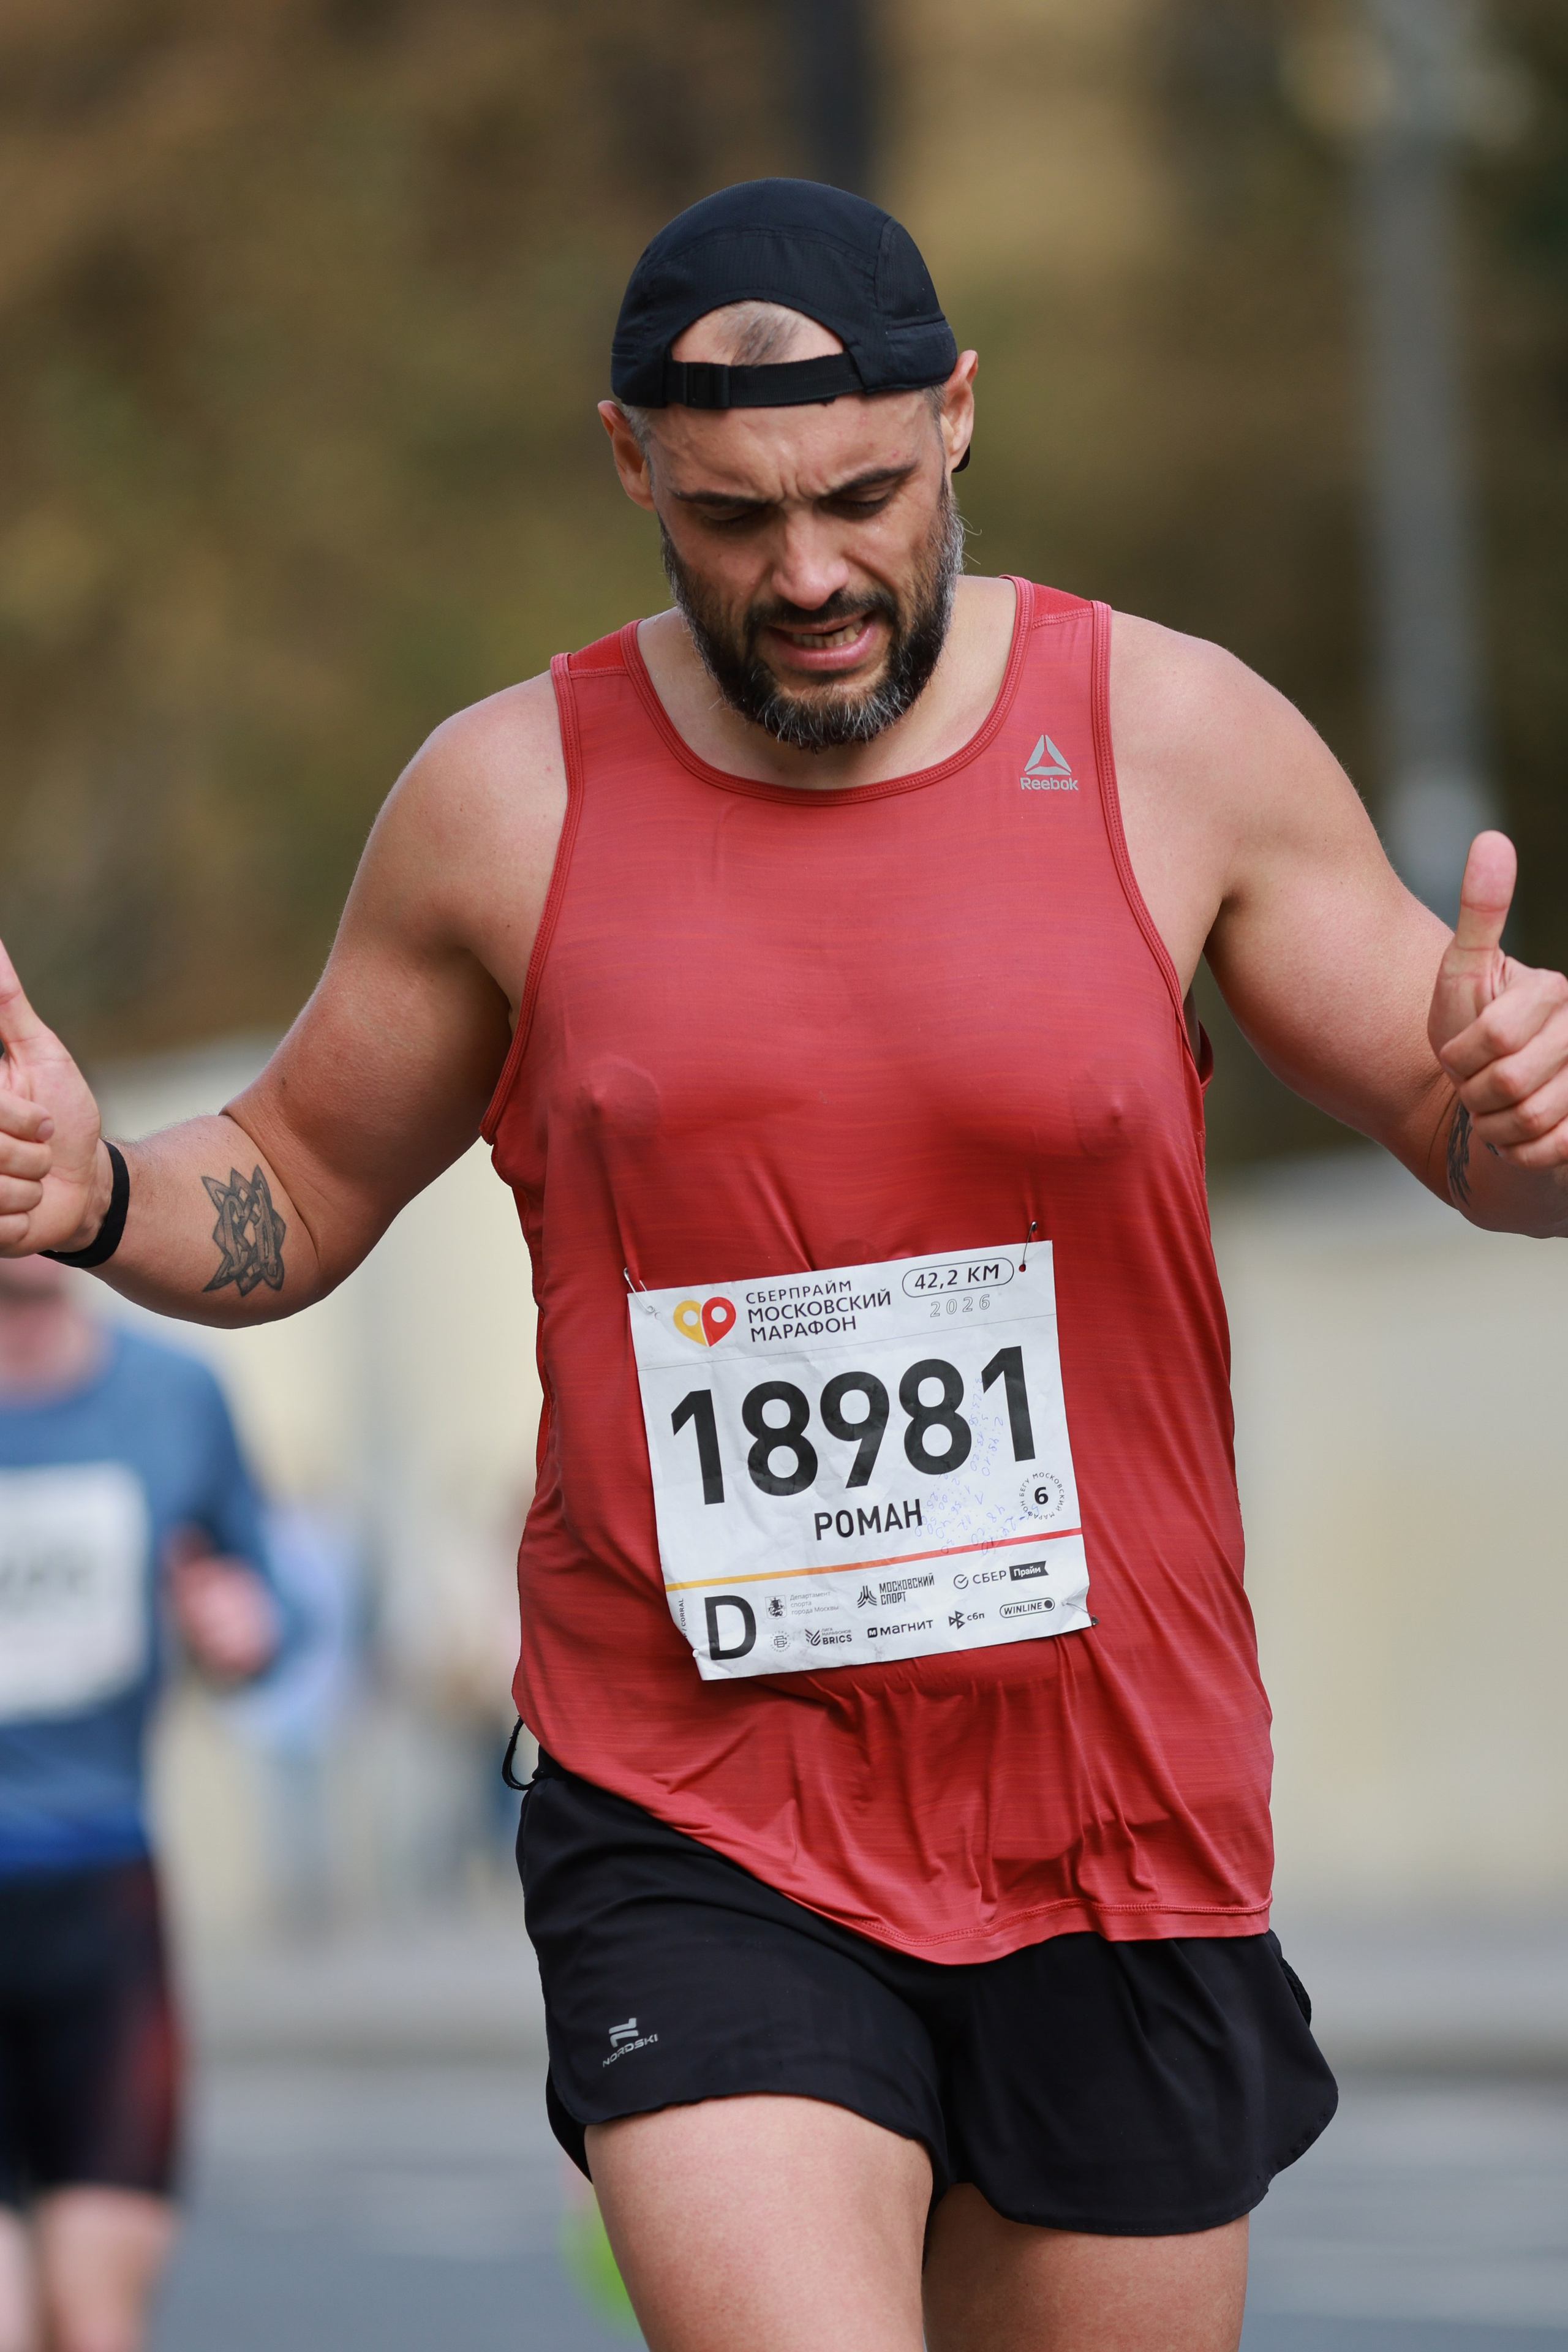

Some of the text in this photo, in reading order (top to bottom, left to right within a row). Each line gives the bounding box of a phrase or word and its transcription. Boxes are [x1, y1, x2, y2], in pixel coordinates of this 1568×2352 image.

[1020, 777, 1079, 791] Reebok
[914, 1264, 999, 1289] 42,2 КМ
[746, 1280, 851, 1304] СБЕРПРАЙМ
[748, 1288, 891, 1324] МОСКОВСКИЙ
[930, 1294, 990, 1317] 2026
[750, 1316, 856, 1342] МАРАФОН
[670, 1346, 1036, 1505] 18981
[1019, 1478, 1030, 1497] БЕГУ
[1032, 1472, 1065, 1512] МОСКОВСКИЙ
[1034, 1487, 1049, 1505] 6
[815, 1499, 922, 1540] РОМАН
[879, 1573, 935, 1594] МОСКОВСКИЙ
[973, 1566, 1041, 1584] СБЕР Прайм
[790, 1591, 831, 1601] Департамент
[881, 1591, 906, 1605] СПОРТ
[967, 1612, 985, 1621] сбп
[1004, 1602, 1042, 1615] WINLINE
[704, 1595, 757, 1660] D
[880, 1620, 933, 1636] магнит
[823, 1634, 853, 1645] BRICS
[603, 2034, 658, 2068] NORDSKI
